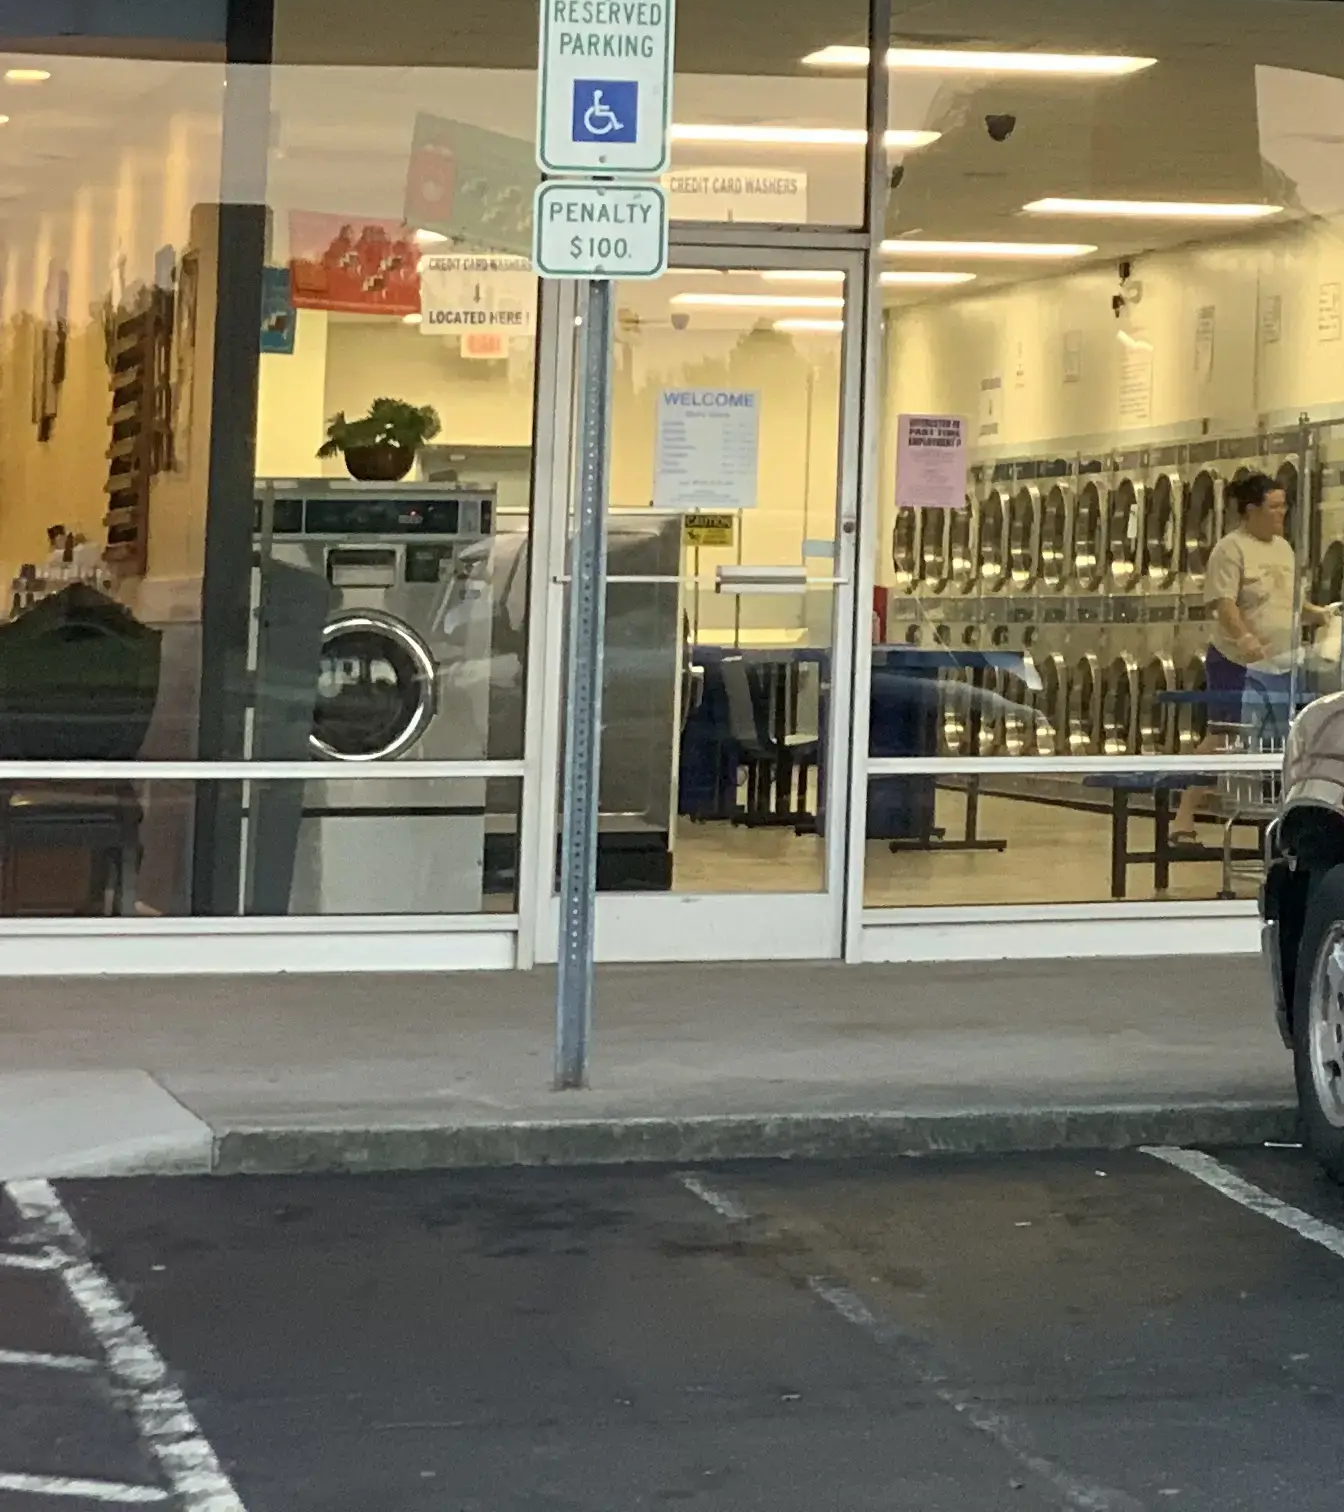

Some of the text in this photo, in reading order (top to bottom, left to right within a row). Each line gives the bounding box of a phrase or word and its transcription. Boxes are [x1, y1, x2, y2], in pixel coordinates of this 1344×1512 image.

[553, 0, 662, 26] RESERVED
[559, 32, 654, 58] PARKING
[669, 176, 798, 196] CREDIT CARD WASHERS
[549, 201, 653, 224] PENALTY
[428, 310, 486, 325] LOCATED
[489, 311, 523, 325] HERE
[663, 391, 755, 408] WELCOME
